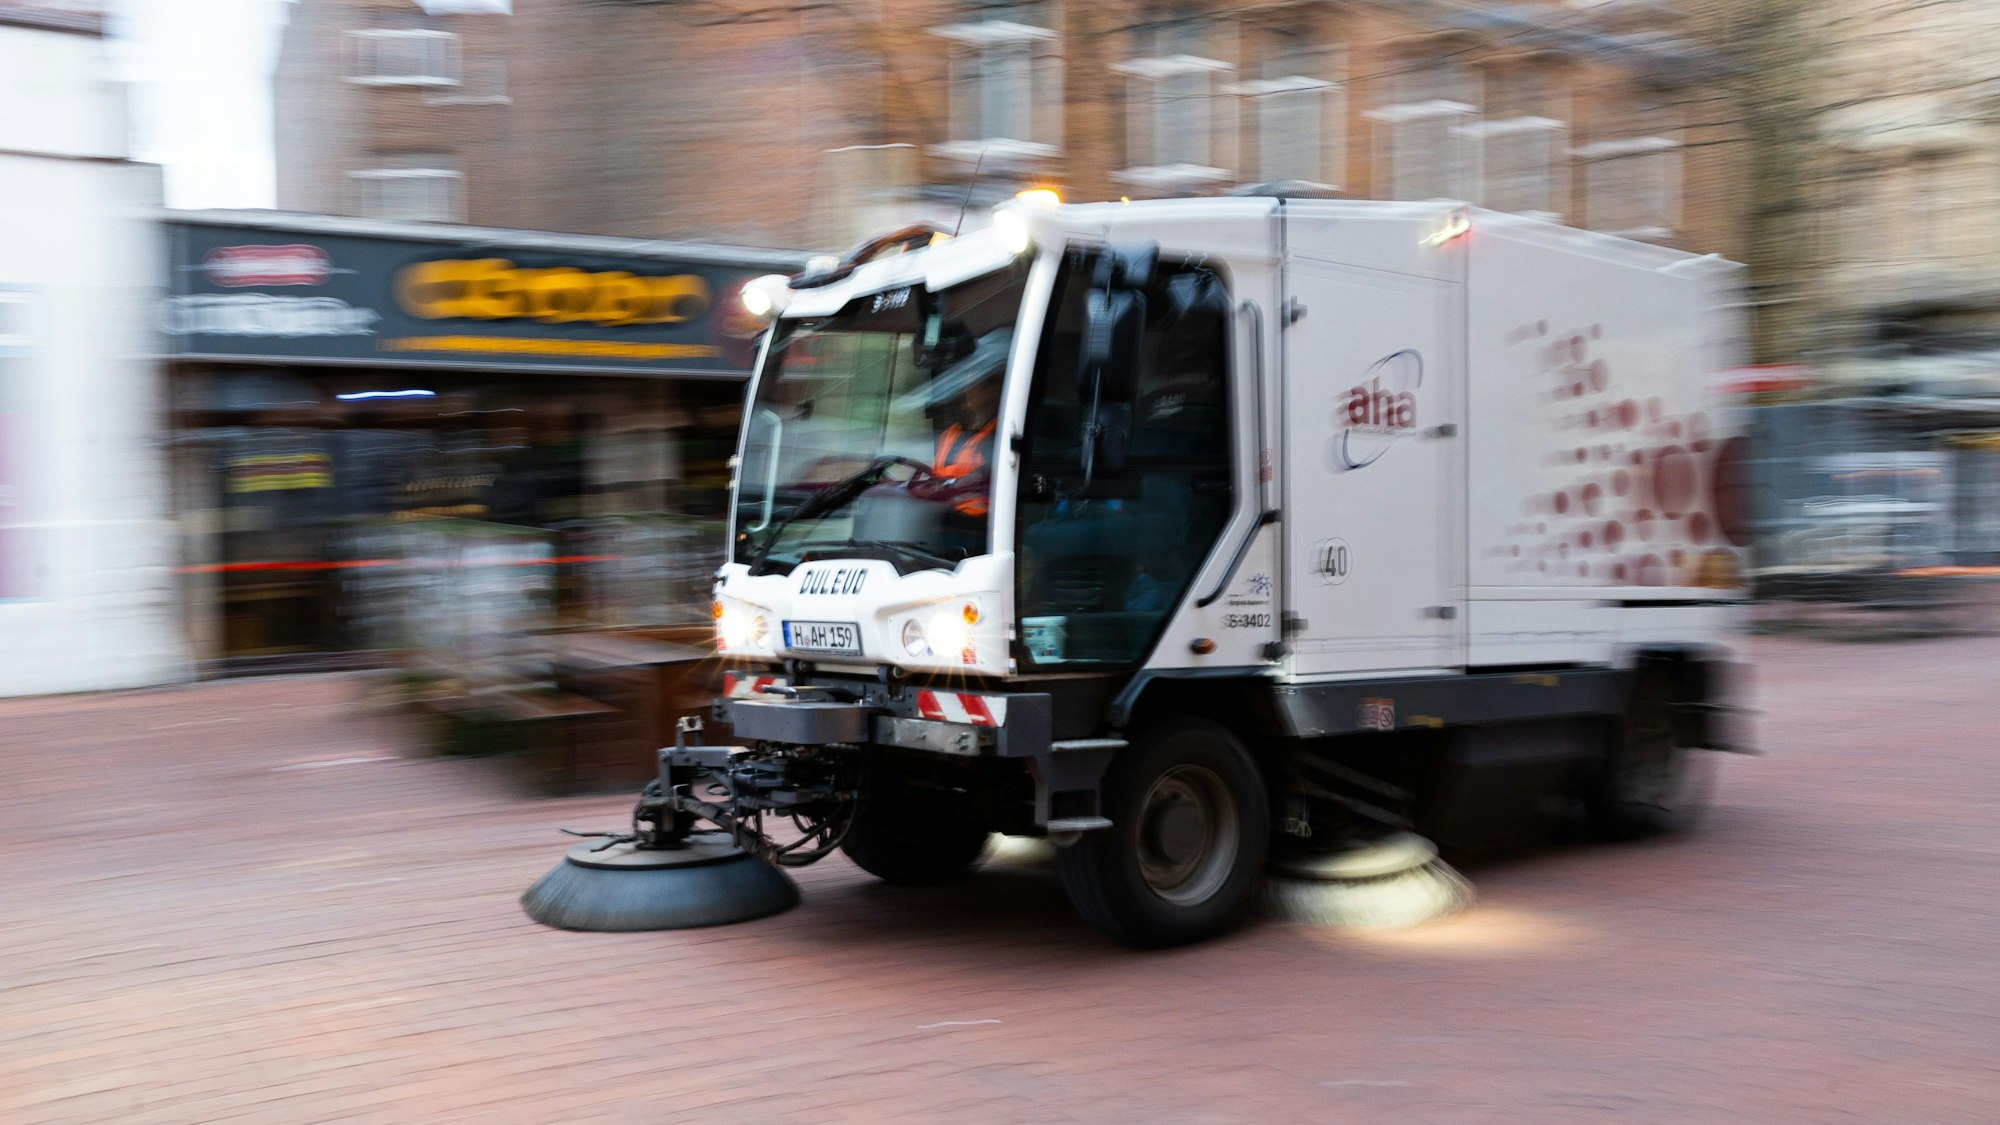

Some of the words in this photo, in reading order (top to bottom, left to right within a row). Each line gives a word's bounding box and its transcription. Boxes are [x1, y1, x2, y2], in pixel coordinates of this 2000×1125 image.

[1347, 376, 1417, 428] aha
[1325, 546, 1348, 577] 40
[1227, 613, 1271, 628] S-3402
[794, 625, 804, 646] H
[811, 625, 828, 647] AH
[829, 626, 853, 648] 159
